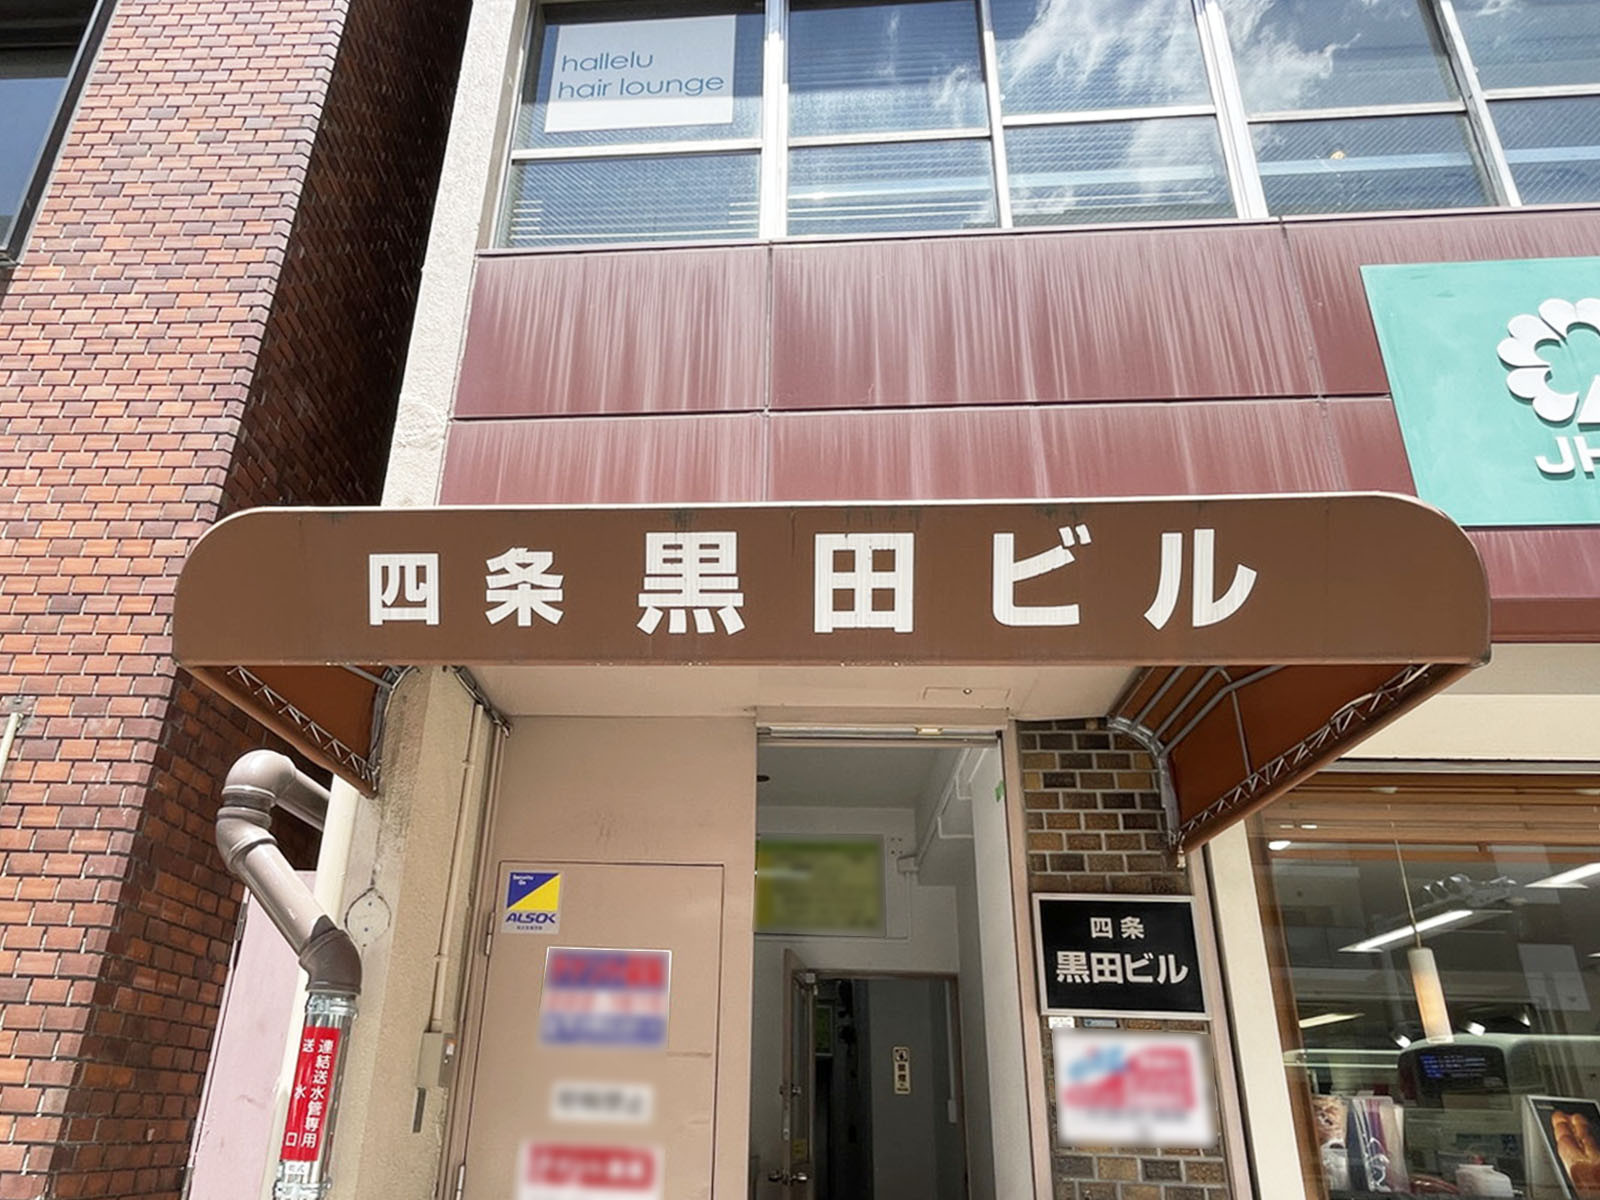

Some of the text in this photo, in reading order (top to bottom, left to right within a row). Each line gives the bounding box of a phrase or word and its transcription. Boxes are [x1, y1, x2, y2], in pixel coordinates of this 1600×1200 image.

[561, 51, 653, 72] hallelu
[558, 75, 724, 99] hair lounge
[366, 525, 1257, 635] 四条黒田ビル
[506, 912, 556, 924] ALSOK
[1090, 916, 1145, 939] 四条
[1056, 951, 1189, 984] 黒田ビル
[301, 1039, 334, 1149] 連結送水管専用
